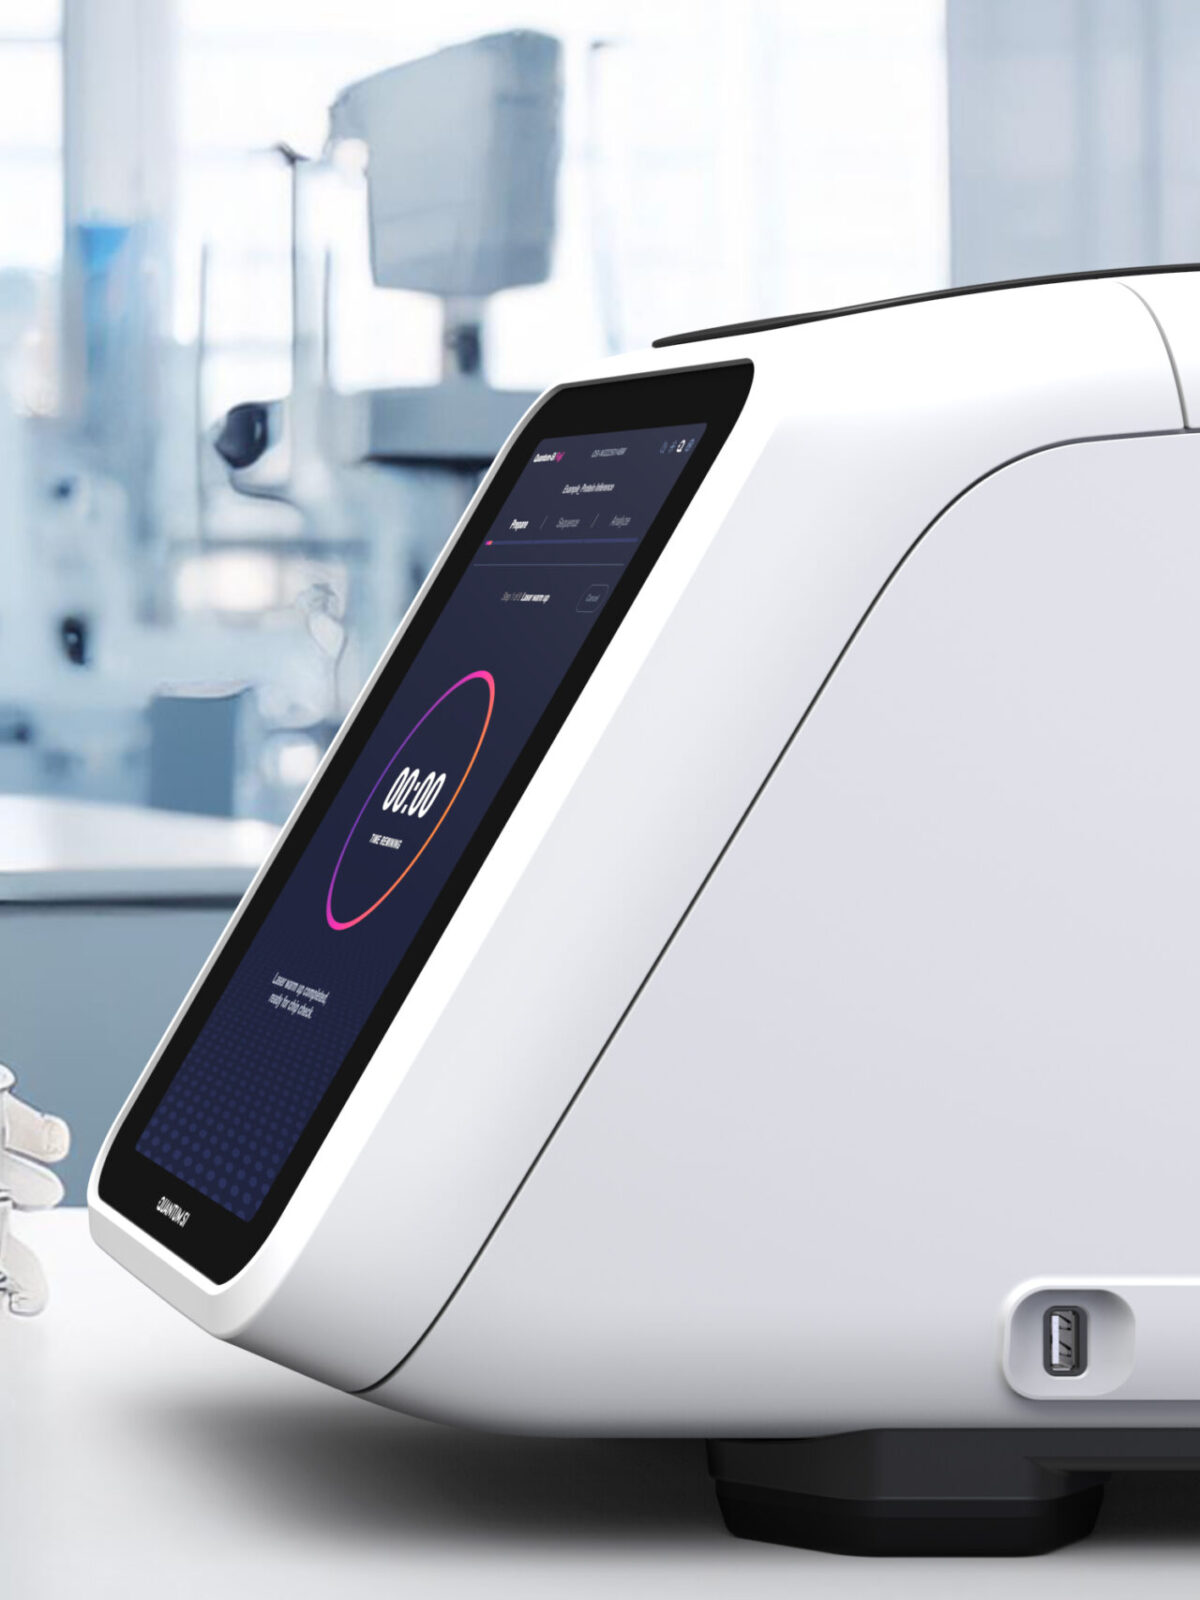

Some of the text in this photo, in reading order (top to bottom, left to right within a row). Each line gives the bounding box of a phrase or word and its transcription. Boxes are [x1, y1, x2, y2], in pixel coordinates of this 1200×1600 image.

[509, 519, 529, 531] Prepare
[382, 766, 447, 818] 00:00
[369, 833, 383, 845] TIME
[272, 971, 288, 987] Laser
[284, 979, 299, 992] warm
[296, 984, 305, 997] up
[268, 993, 283, 1008] ready
[280, 995, 290, 1008] for
[287, 999, 300, 1015] chip
